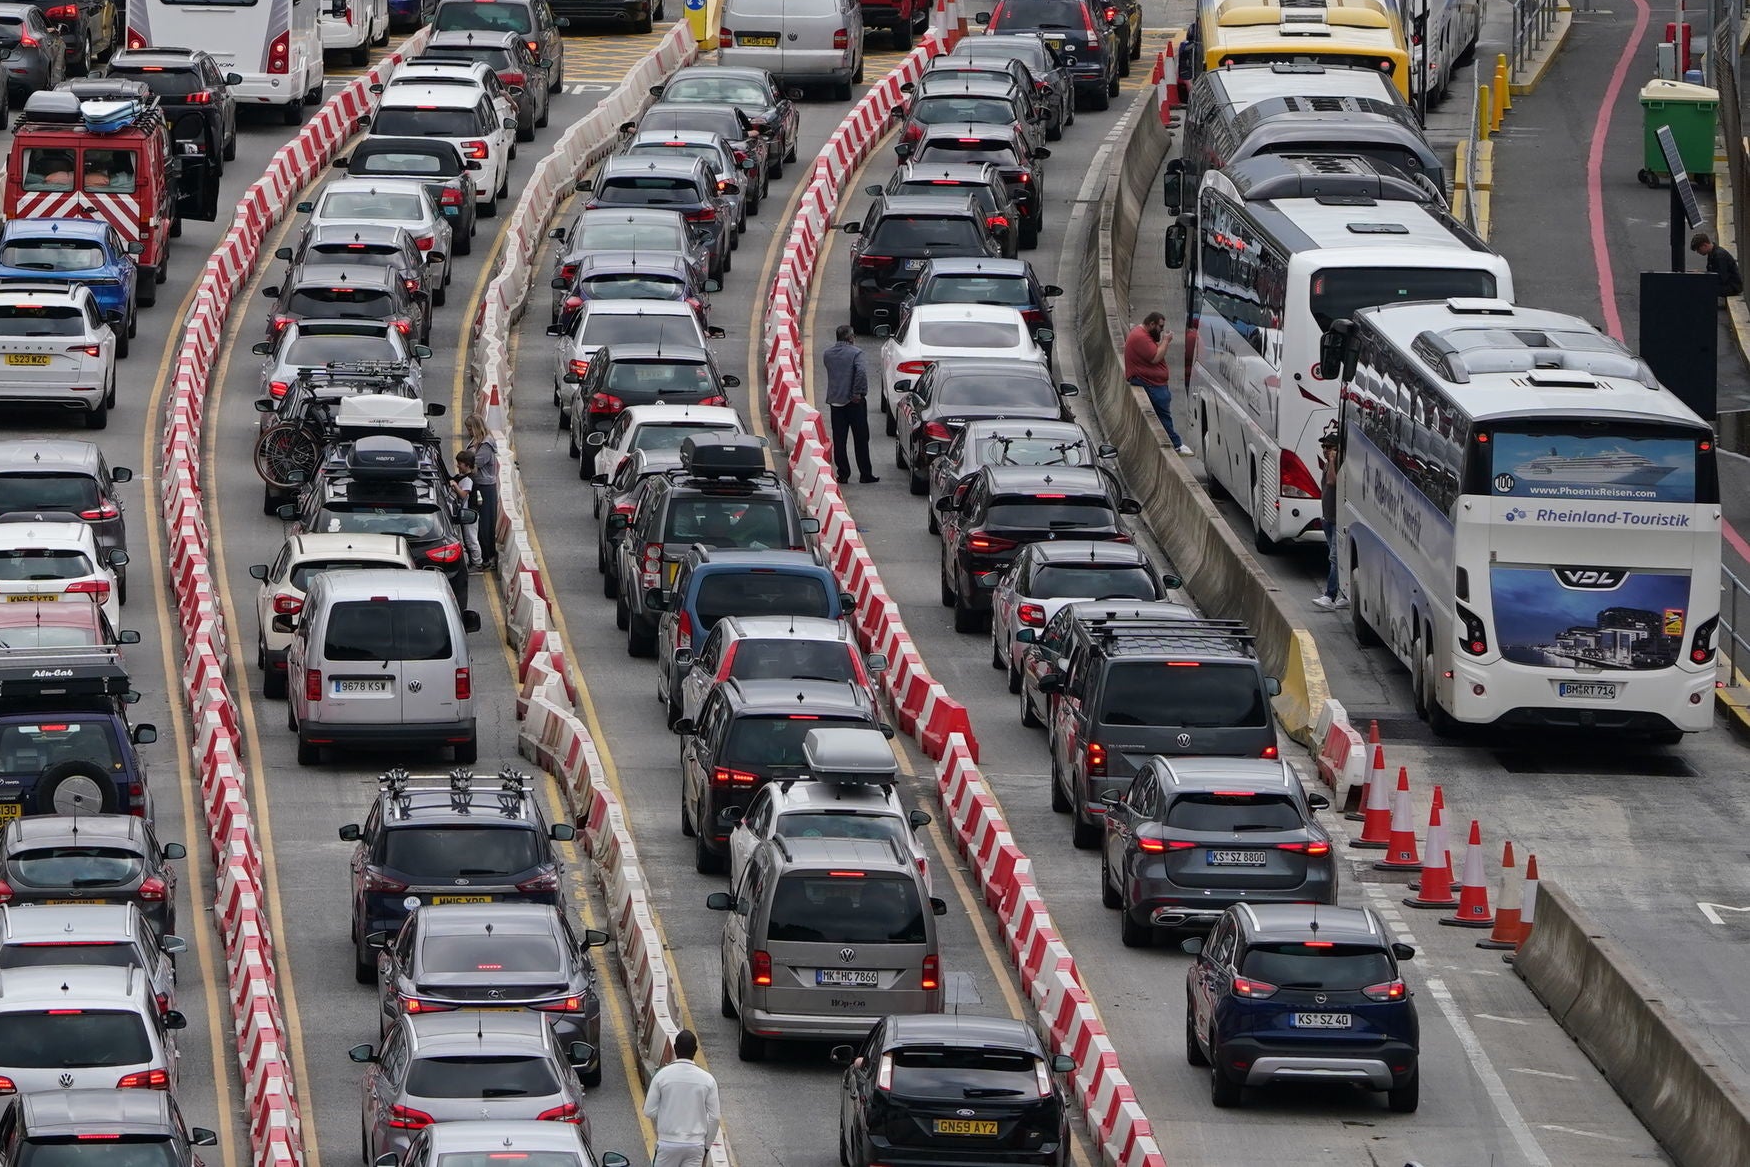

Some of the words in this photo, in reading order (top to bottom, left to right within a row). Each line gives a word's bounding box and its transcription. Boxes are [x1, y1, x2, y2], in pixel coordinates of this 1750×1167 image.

[8, 355, 30, 364] LS23
[31, 355, 47, 364] WZC
[1530, 486, 1657, 500] www.PhoenixReisen.com
[1537, 508, 1690, 528] Rheinland-Touristik
[1564, 570, 1615, 585] VDL
[32, 668, 74, 678] Alu-Cab
[341, 682, 366, 692] 9678
[368, 682, 387, 692] KSW
[1566, 684, 1579, 694] BM
[1583, 684, 1595, 695] RT
[1597, 685, 1614, 696] 714
[1213, 851, 1226, 861] KS
[1230, 851, 1243, 862] SZ
[1244, 852, 1267, 863] 8800
[406, 897, 418, 906] UK
[823, 971, 835, 982] MK
[840, 971, 853, 982] HC
[854, 972, 878, 984] 7866
[1298, 1014, 1313, 1025] KS
[1320, 1015, 1335, 1026] SZ
[1335, 1016, 1349, 1026] 40
[940, 1121, 971, 1134] GN59
[973, 1122, 997, 1134] AYZ
